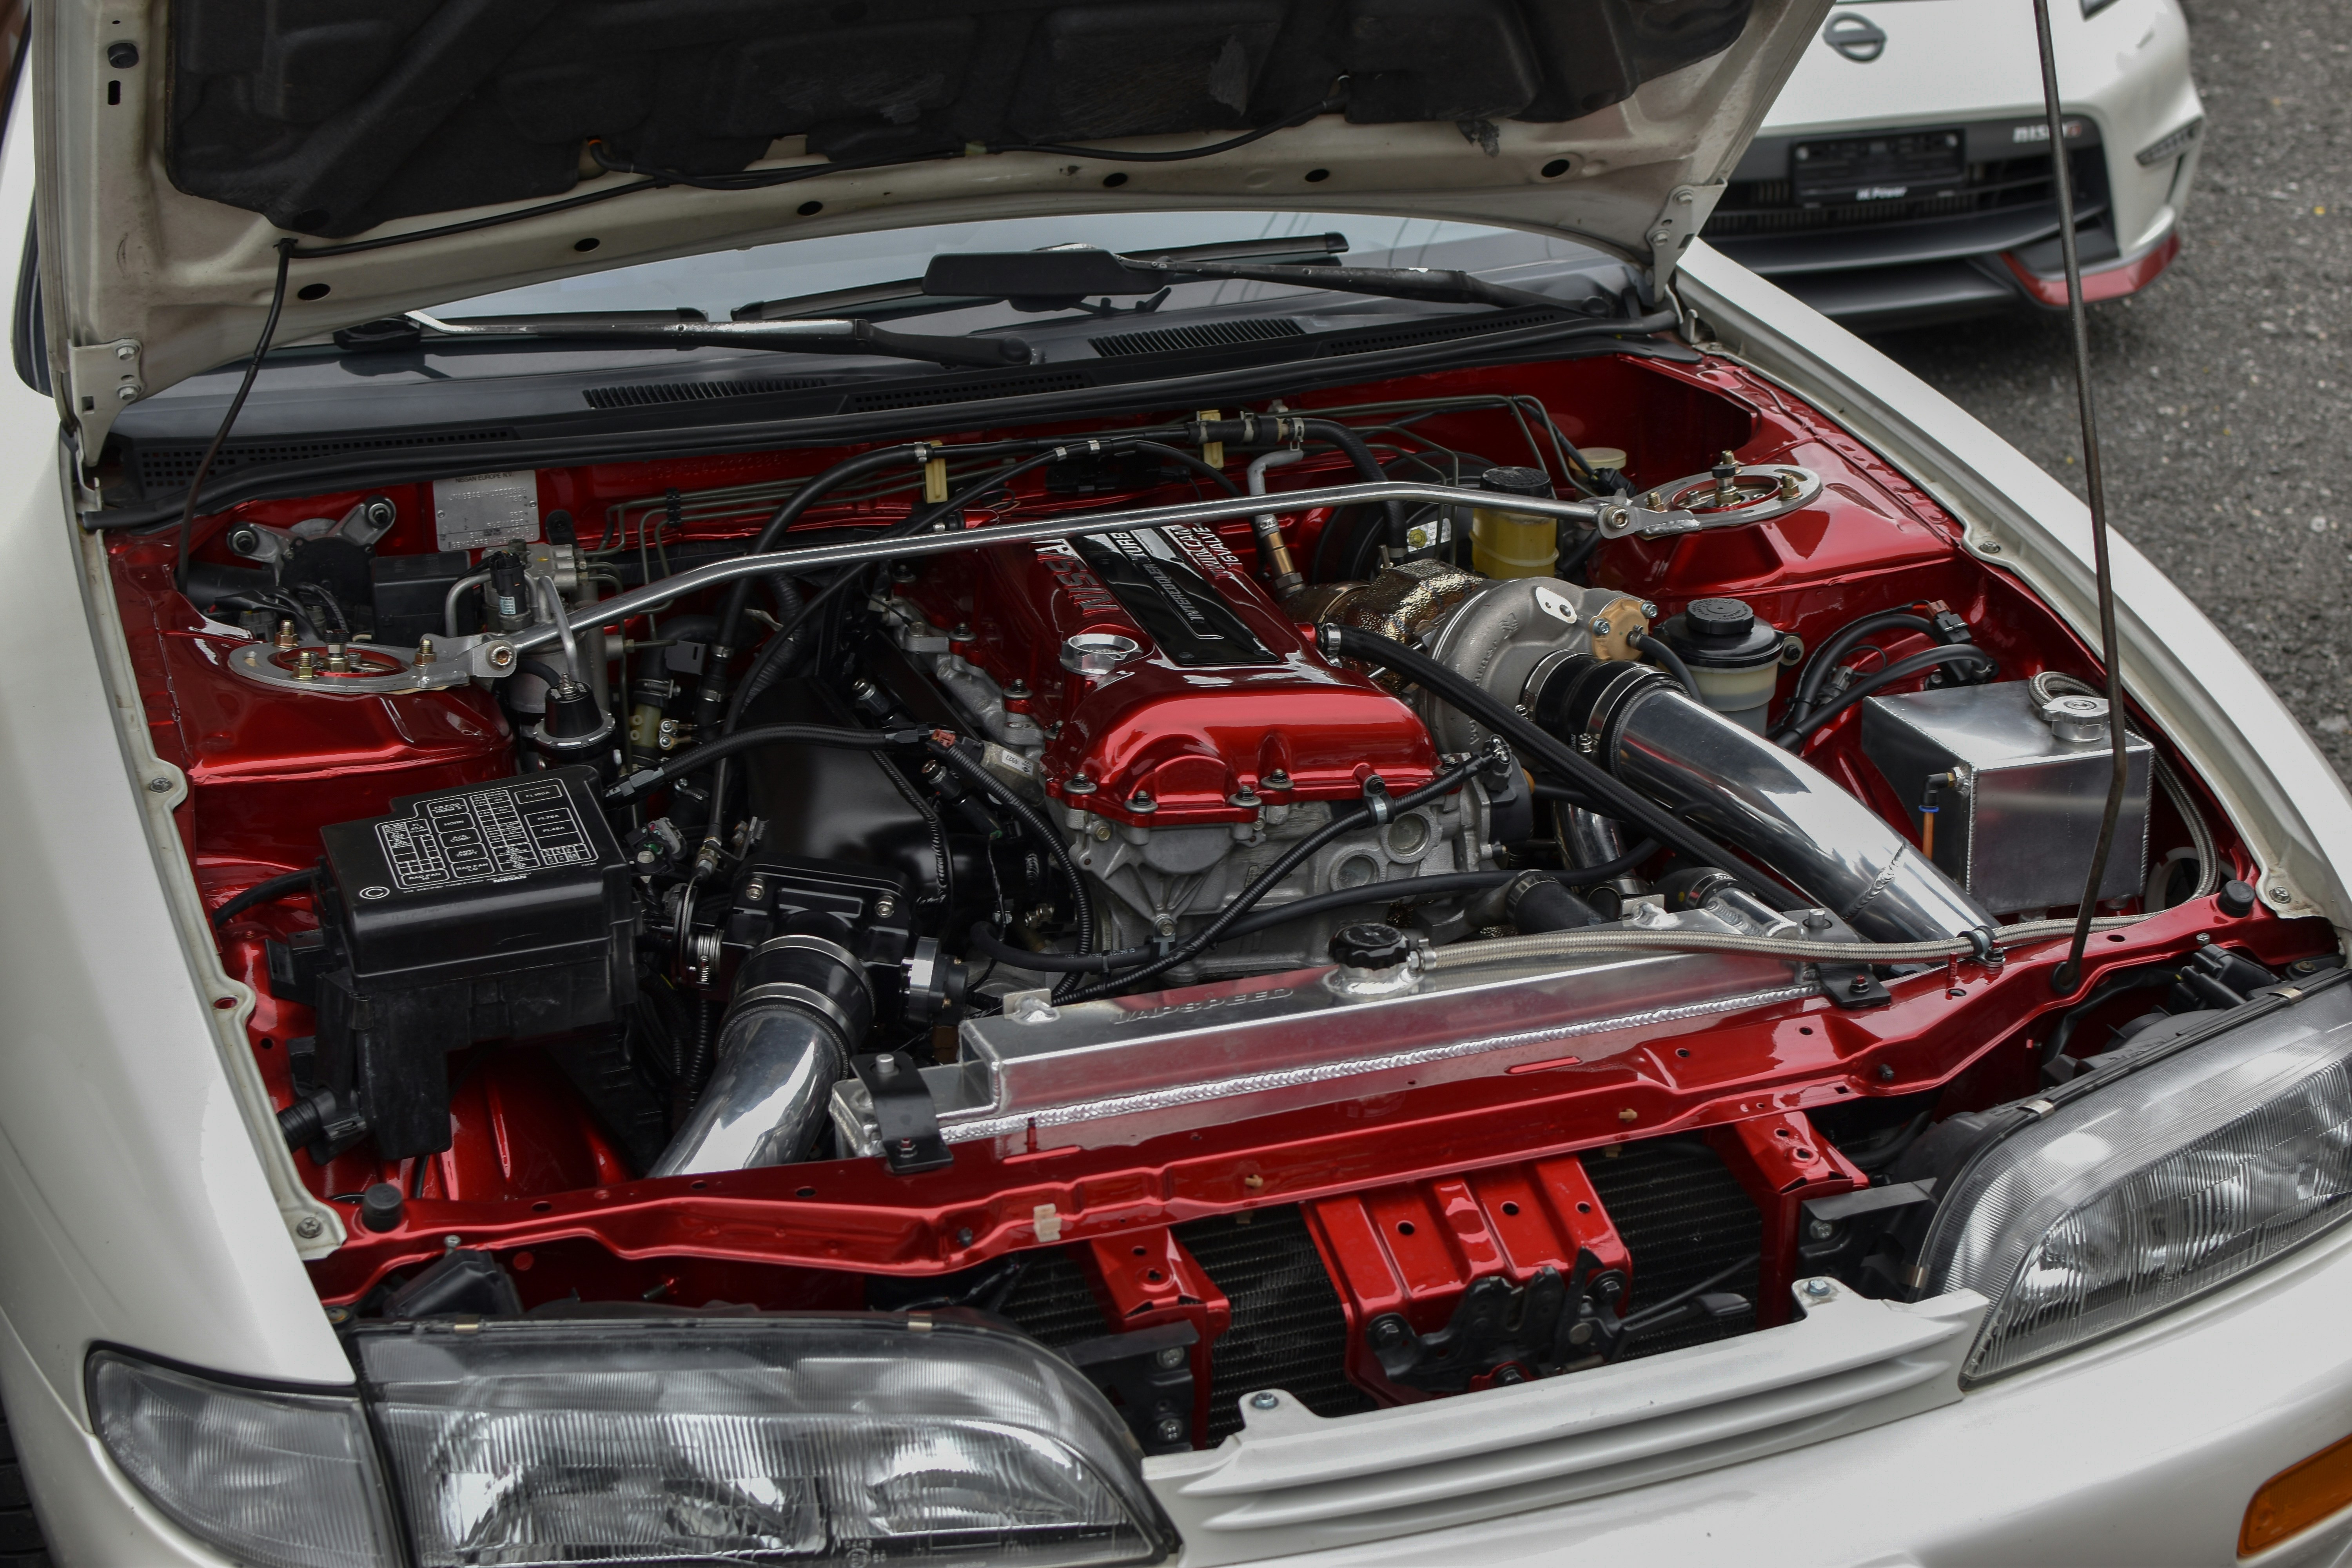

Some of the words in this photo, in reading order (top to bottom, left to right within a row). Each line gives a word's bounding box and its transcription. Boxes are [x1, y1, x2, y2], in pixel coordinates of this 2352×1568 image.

[2013, 121, 2082, 143] niso
[1031, 539, 1121, 616] NISSA
[1143, 563, 1205, 623] INTERCOOLER
[1469, 640, 1498, 745] Borarner
[1114, 988, 1293, 1025] JAPSPEED
